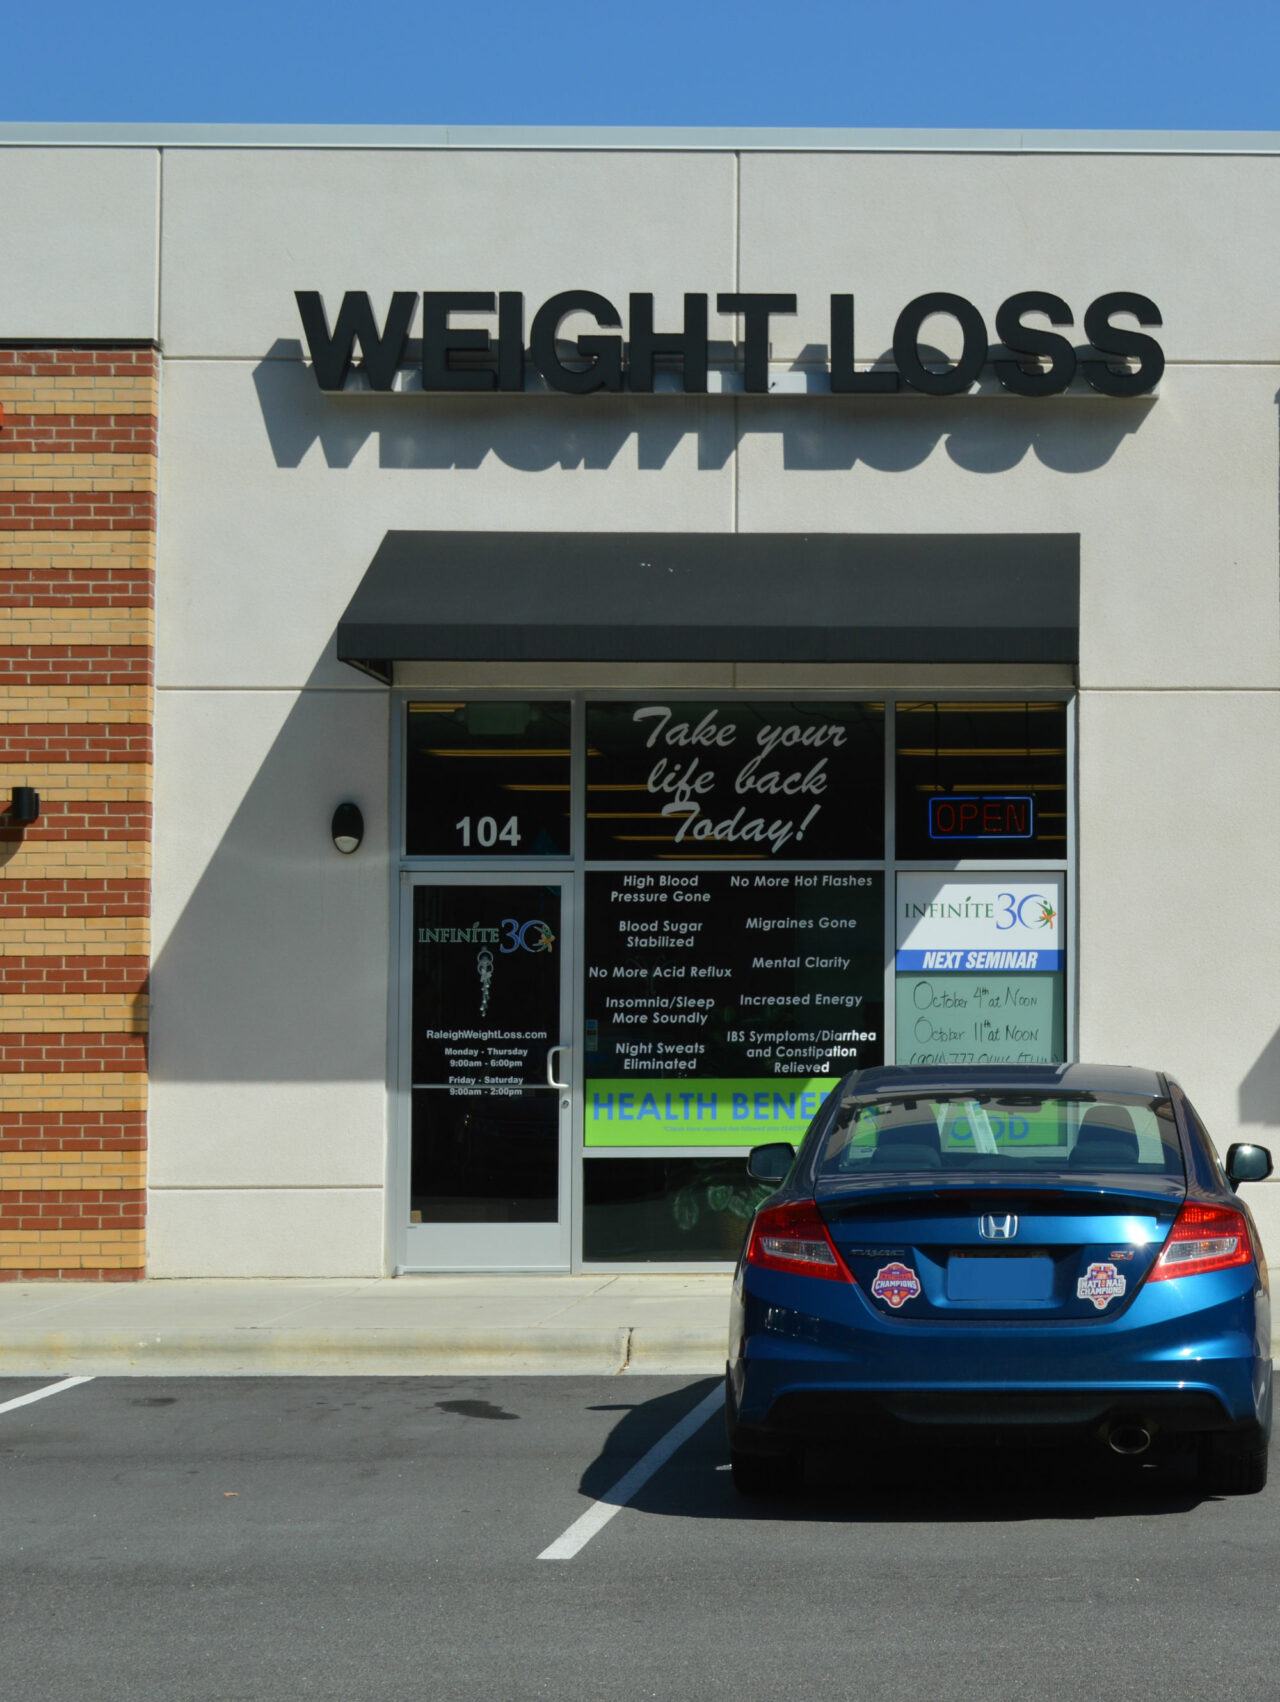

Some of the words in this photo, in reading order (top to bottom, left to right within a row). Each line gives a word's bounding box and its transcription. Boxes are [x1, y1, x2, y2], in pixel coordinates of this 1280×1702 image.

[294, 290, 796, 394] WEIGHT
[830, 291, 1165, 396] LOSS
[633, 706, 737, 748] Take
[756, 724, 848, 759] your
[647, 757, 715, 804] life
[735, 756, 829, 795] back
[936, 803, 1026, 832] OPEN
[456, 815, 522, 847] 104
[661, 802, 822, 853] Today!
[623, 875, 654, 889] High
[659, 875, 699, 887] Blood
[730, 875, 749, 887] No
[754, 875, 790, 887] More
[794, 875, 818, 887] Hot
[822, 875, 873, 886] Flashes
[611, 891, 668, 902] Pressure
[673, 891, 711, 902] Gone
[905, 896, 994, 918] INFINITE
[619, 920, 659, 932] Blood
[663, 920, 703, 934] Sugar
[745, 917, 814, 932] Migraines
[818, 917, 857, 929] Gone
[418, 922, 499, 943] INFINITE
[627, 936, 694, 948] Stabilized
[752, 957, 801, 969] Mental
[804, 956, 851, 971] Clarity
[922, 951, 964, 969] NEXT
[965, 951, 1038, 969] SEMINAR
[589, 966, 608, 978] No
[612, 966, 648, 978] More
[653, 966, 685, 978] Acid
[690, 966, 732, 978] Reflux
[740, 994, 811, 1006] Increased
[815, 994, 863, 1007] Energy
[913, 981, 968, 1010] October
[988, 996, 1002, 1009] at
[605, 996, 715, 1010] Insomnia/Sleep
[612, 1012, 648, 1024] More
[652, 1012, 708, 1026] Soundly
[426, 1030, 547, 1040] RaleighWeightLoss.com
[727, 1030, 745, 1042] IBS
[749, 1030, 876, 1044] Symptoms/Diarrhea
[914, 1016, 965, 1044] October
[987, 1030, 1001, 1042] at
[444, 1047, 479, 1057] Monday
[487, 1047, 528, 1057] Thursday
[615, 1042, 653, 1056] Night
[656, 1042, 705, 1054] Sweats
[746, 1046, 771, 1058] and
[776, 1046, 857, 1059] Constipation
[450, 1059, 482, 1067] 9:00am
[490, 1059, 522, 1068] 6:00pm
[623, 1058, 697, 1070] Eliminated
[774, 1061, 830, 1073] Relieved
[449, 1076, 476, 1085] Friday
[484, 1076, 524, 1086] Saturday
[450, 1088, 482, 1096] 9:00am
[490, 1088, 522, 1097] 2:00pm
[592, 1092, 717, 1121] HEALTH
[875, 1280, 917, 1290] CHAMPIONS
